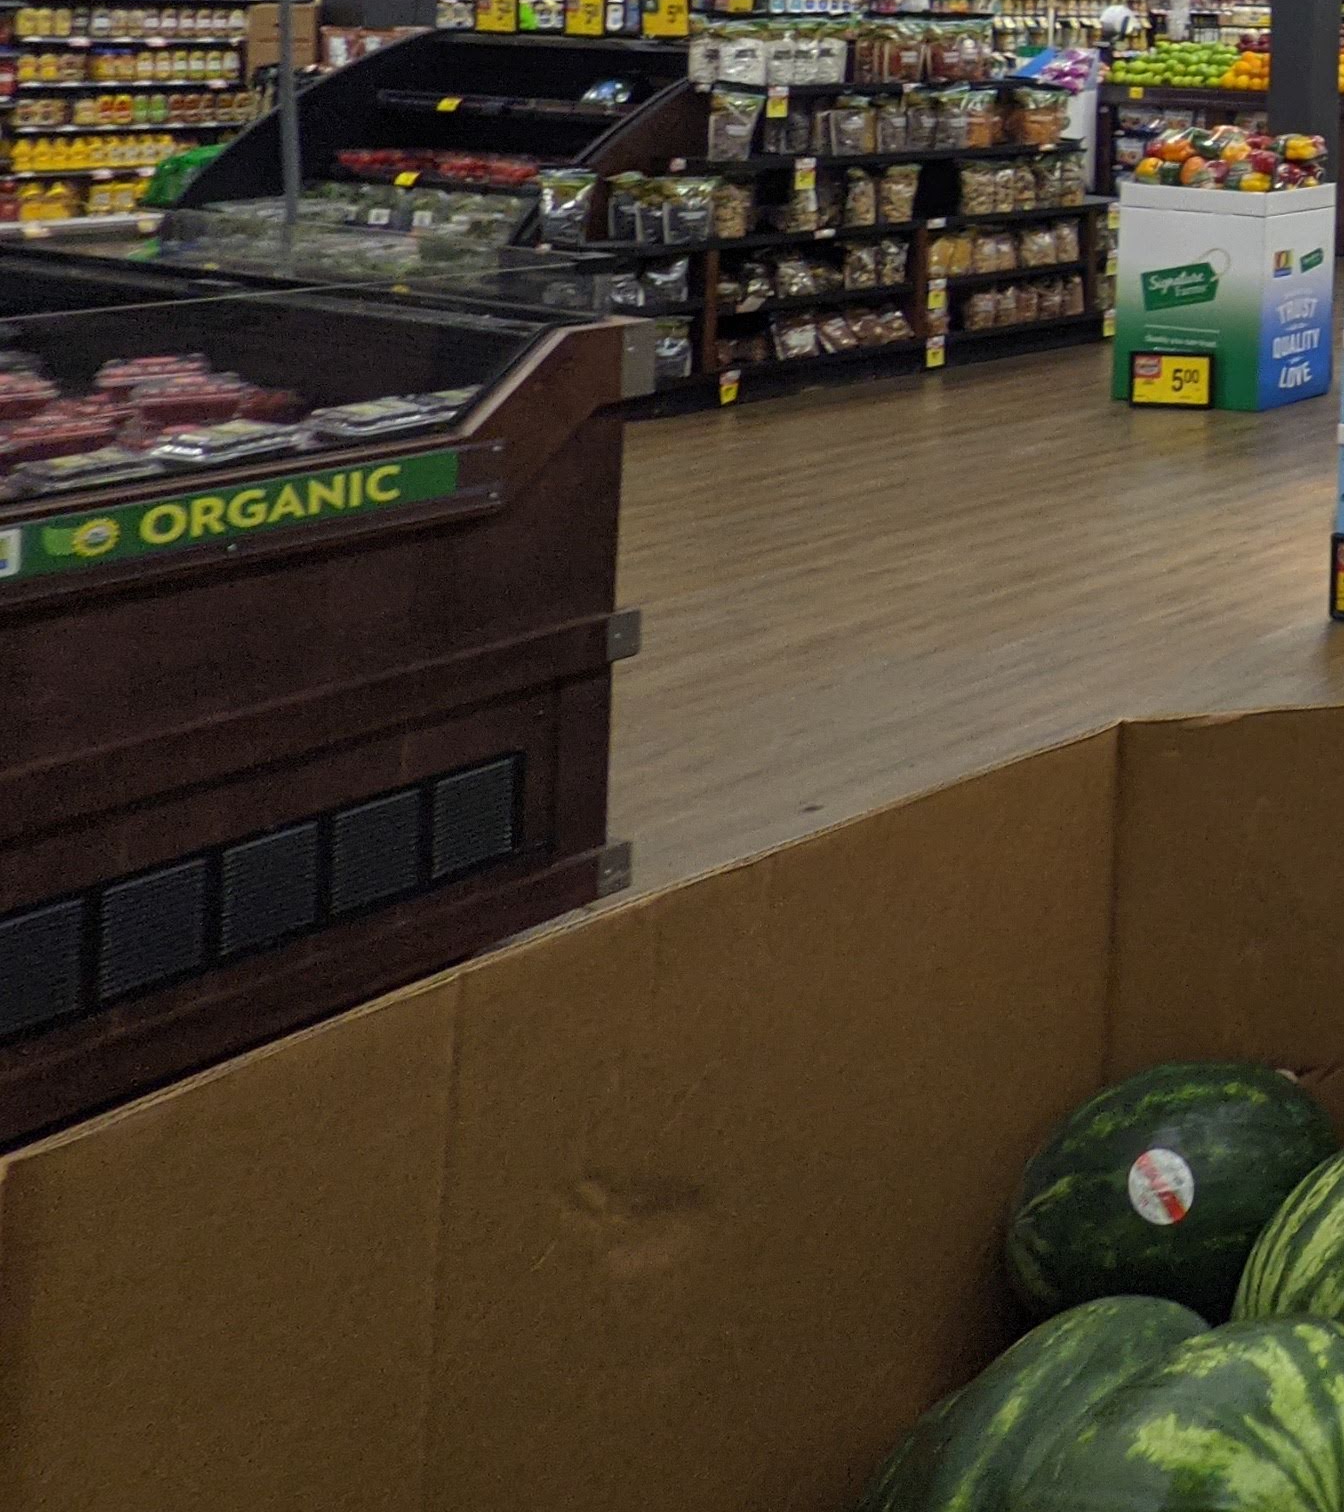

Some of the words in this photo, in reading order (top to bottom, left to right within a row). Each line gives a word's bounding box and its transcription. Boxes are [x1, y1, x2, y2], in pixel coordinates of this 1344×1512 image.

[1277, 297, 1318, 324] TRUST
[1272, 328, 1321, 360] QUALITY
[1278, 363, 1313, 389] LOVE
[139, 464, 402, 544] ORGANIC
